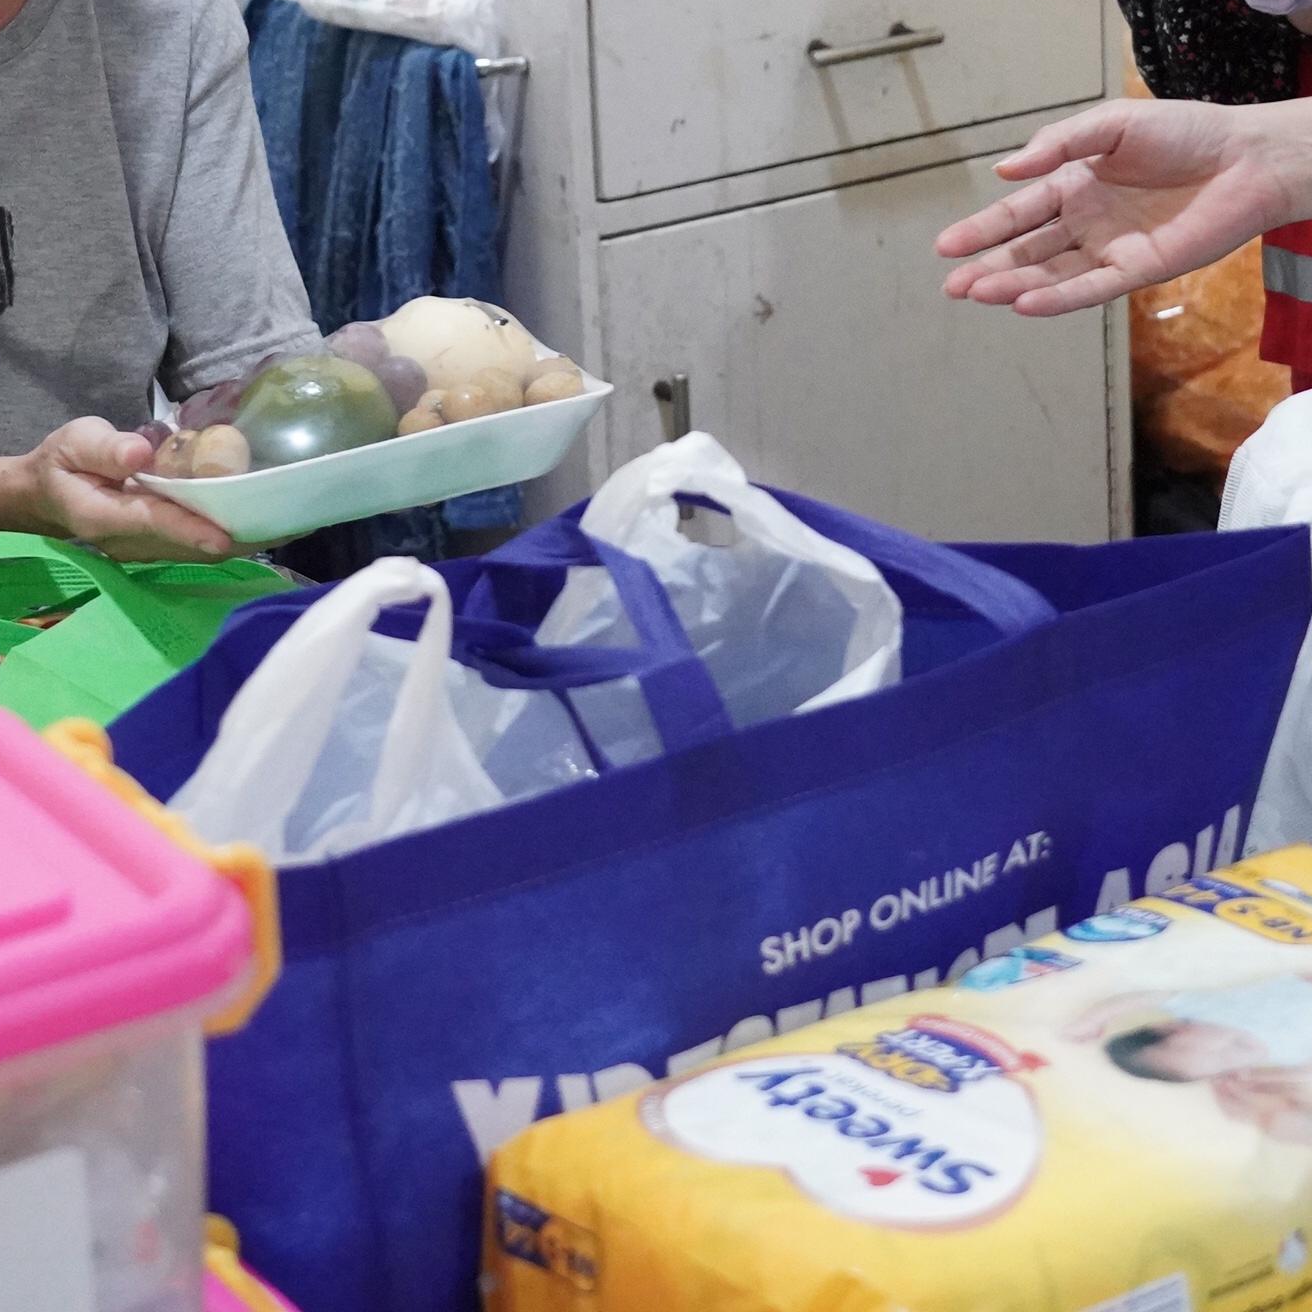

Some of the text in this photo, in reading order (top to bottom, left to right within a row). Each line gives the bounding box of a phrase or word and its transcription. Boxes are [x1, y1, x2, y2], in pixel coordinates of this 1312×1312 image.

[759, 906, 863, 976] SHOP
[868, 850, 1000, 932] ONLINE
[1001, 828, 1053, 875] AT:
[736, 1069, 996, 1192] Sweety
